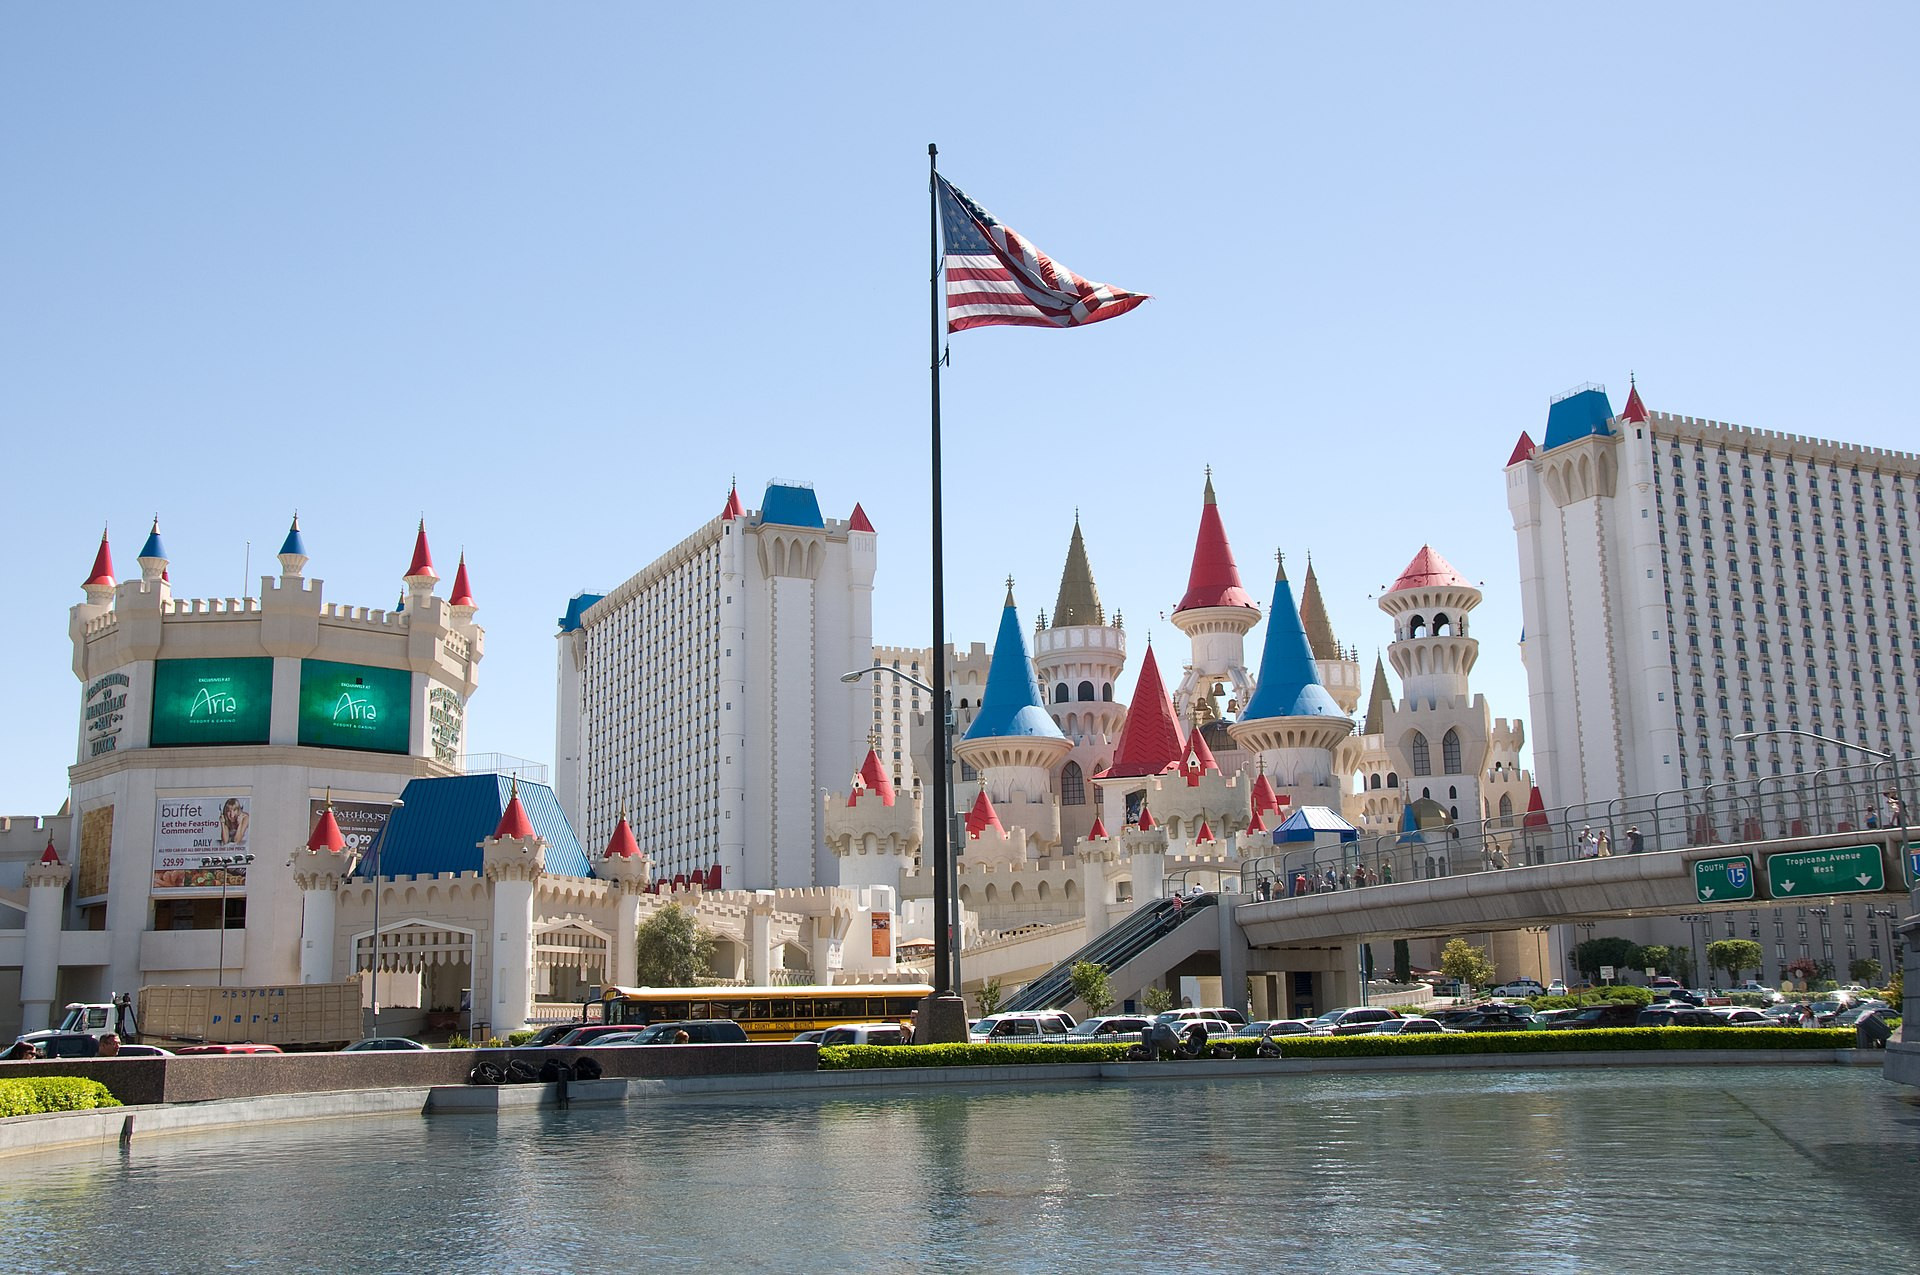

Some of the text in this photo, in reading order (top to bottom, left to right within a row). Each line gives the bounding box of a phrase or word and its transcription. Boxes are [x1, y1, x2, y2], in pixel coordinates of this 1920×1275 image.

[190, 688, 236, 717] Aria
[333, 692, 377, 720] Aria
[162, 804, 202, 817] buffet
[316, 809, 390, 821] SEAKHOUSE
[188, 820, 219, 828] Feasting
[161, 827, 204, 835] Commence!
[193, 839, 212, 847] DAILY
[162, 858, 184, 867] $29.99
[1785, 853, 1861, 866] Tropicana Avenue
[1698, 864, 1724, 872] SOUTH
[1813, 865, 1834, 873] West
[1731, 868, 1745, 883] 15
